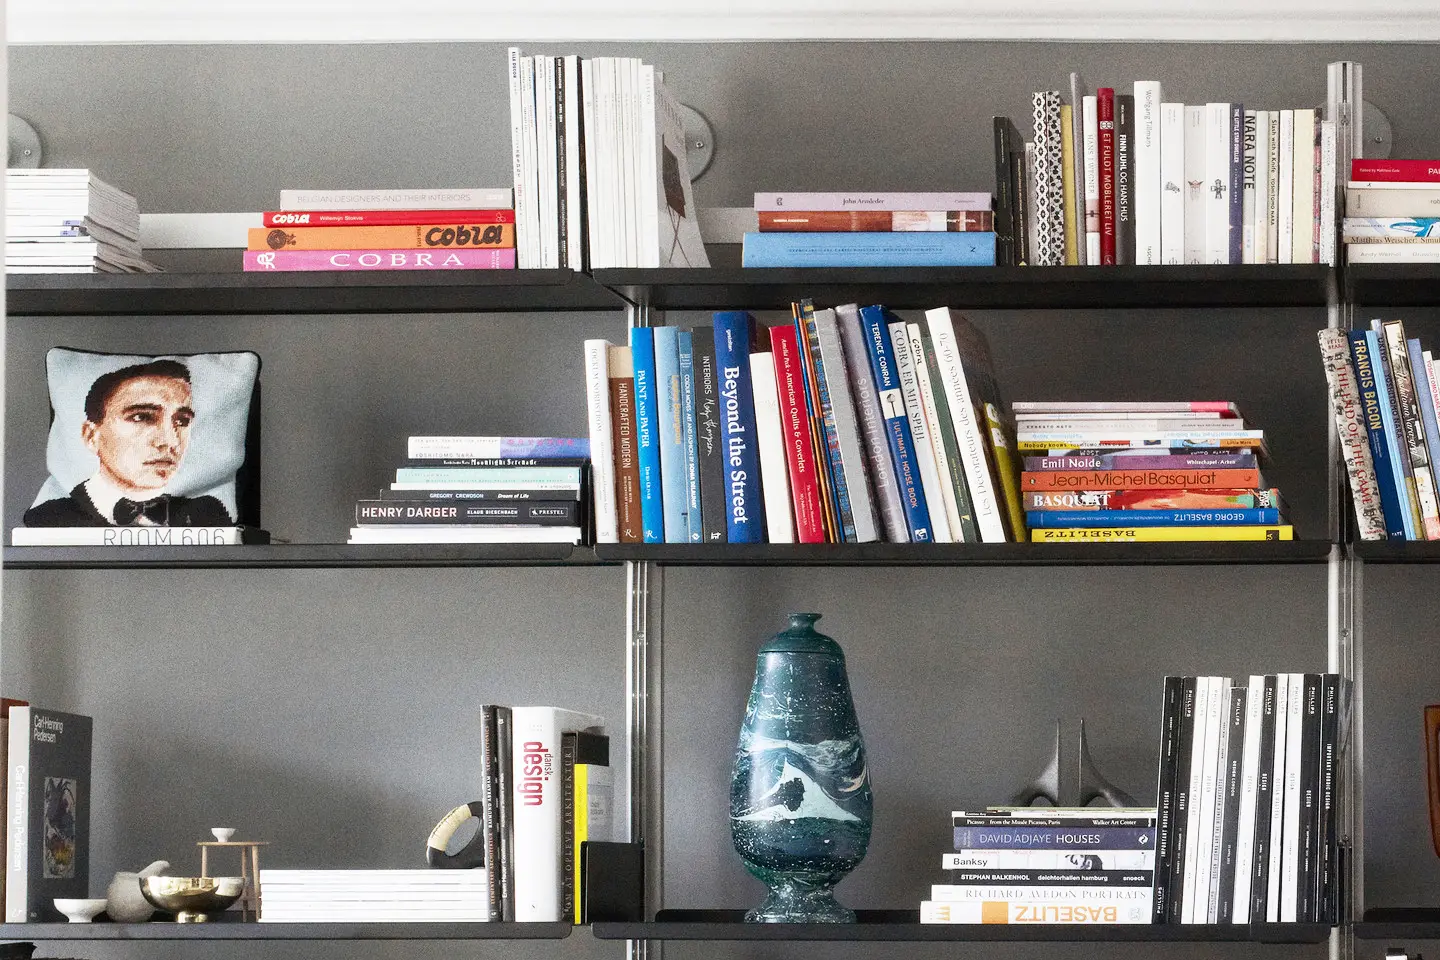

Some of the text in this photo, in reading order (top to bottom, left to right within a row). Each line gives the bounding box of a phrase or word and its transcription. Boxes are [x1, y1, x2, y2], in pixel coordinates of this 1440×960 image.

[1144, 90, 1153, 148] Wolfgang Tillmans
[1119, 134, 1127, 151] FINN
[1244, 116, 1255, 190] NARA NOTE
[1103, 143, 1111, 171] FULDT
[1120, 172, 1128, 182] OG
[1104, 175, 1112, 220] MØBLERET
[1120, 184, 1128, 203] HANS
[1105, 223, 1113, 235] LIV
[330, 253, 464, 266] COBRA
[871, 323, 891, 387] TERENCE CONRAN
[702, 356, 712, 394] INTERIORS
[1353, 340, 1382, 430] FRANCIS BACON
[785, 372, 798, 406] American
[637, 370, 649, 448] PAINT AND PAPER
[789, 407, 802, 430] Quilts
[619, 383, 631, 468] HANDCRAFTED MODERN
[856, 378, 890, 489] London Interiors
[1336, 365, 1372, 505] THE END OF THE GAME
[722, 366, 748, 524] Beyond the Street
[794, 440, 806, 473] Coverlets
[1042, 458, 1101, 469] Emil Nolde
[1049, 472, 1216, 488] Jean-Michel Basquiat
[362, 508, 457, 518] HENRY DARGER
[1173, 513, 1213, 521] BASELITZ
[1044, 530, 1136, 538] BASELITZ
[516, 741, 549, 806] design
[544, 753, 553, 776] dansk
[980, 834, 1100, 845] DAVID ADJAYE HOUSES
[953, 858, 988, 867] Banksy
[1015, 906, 1117, 921] BASELITZ
